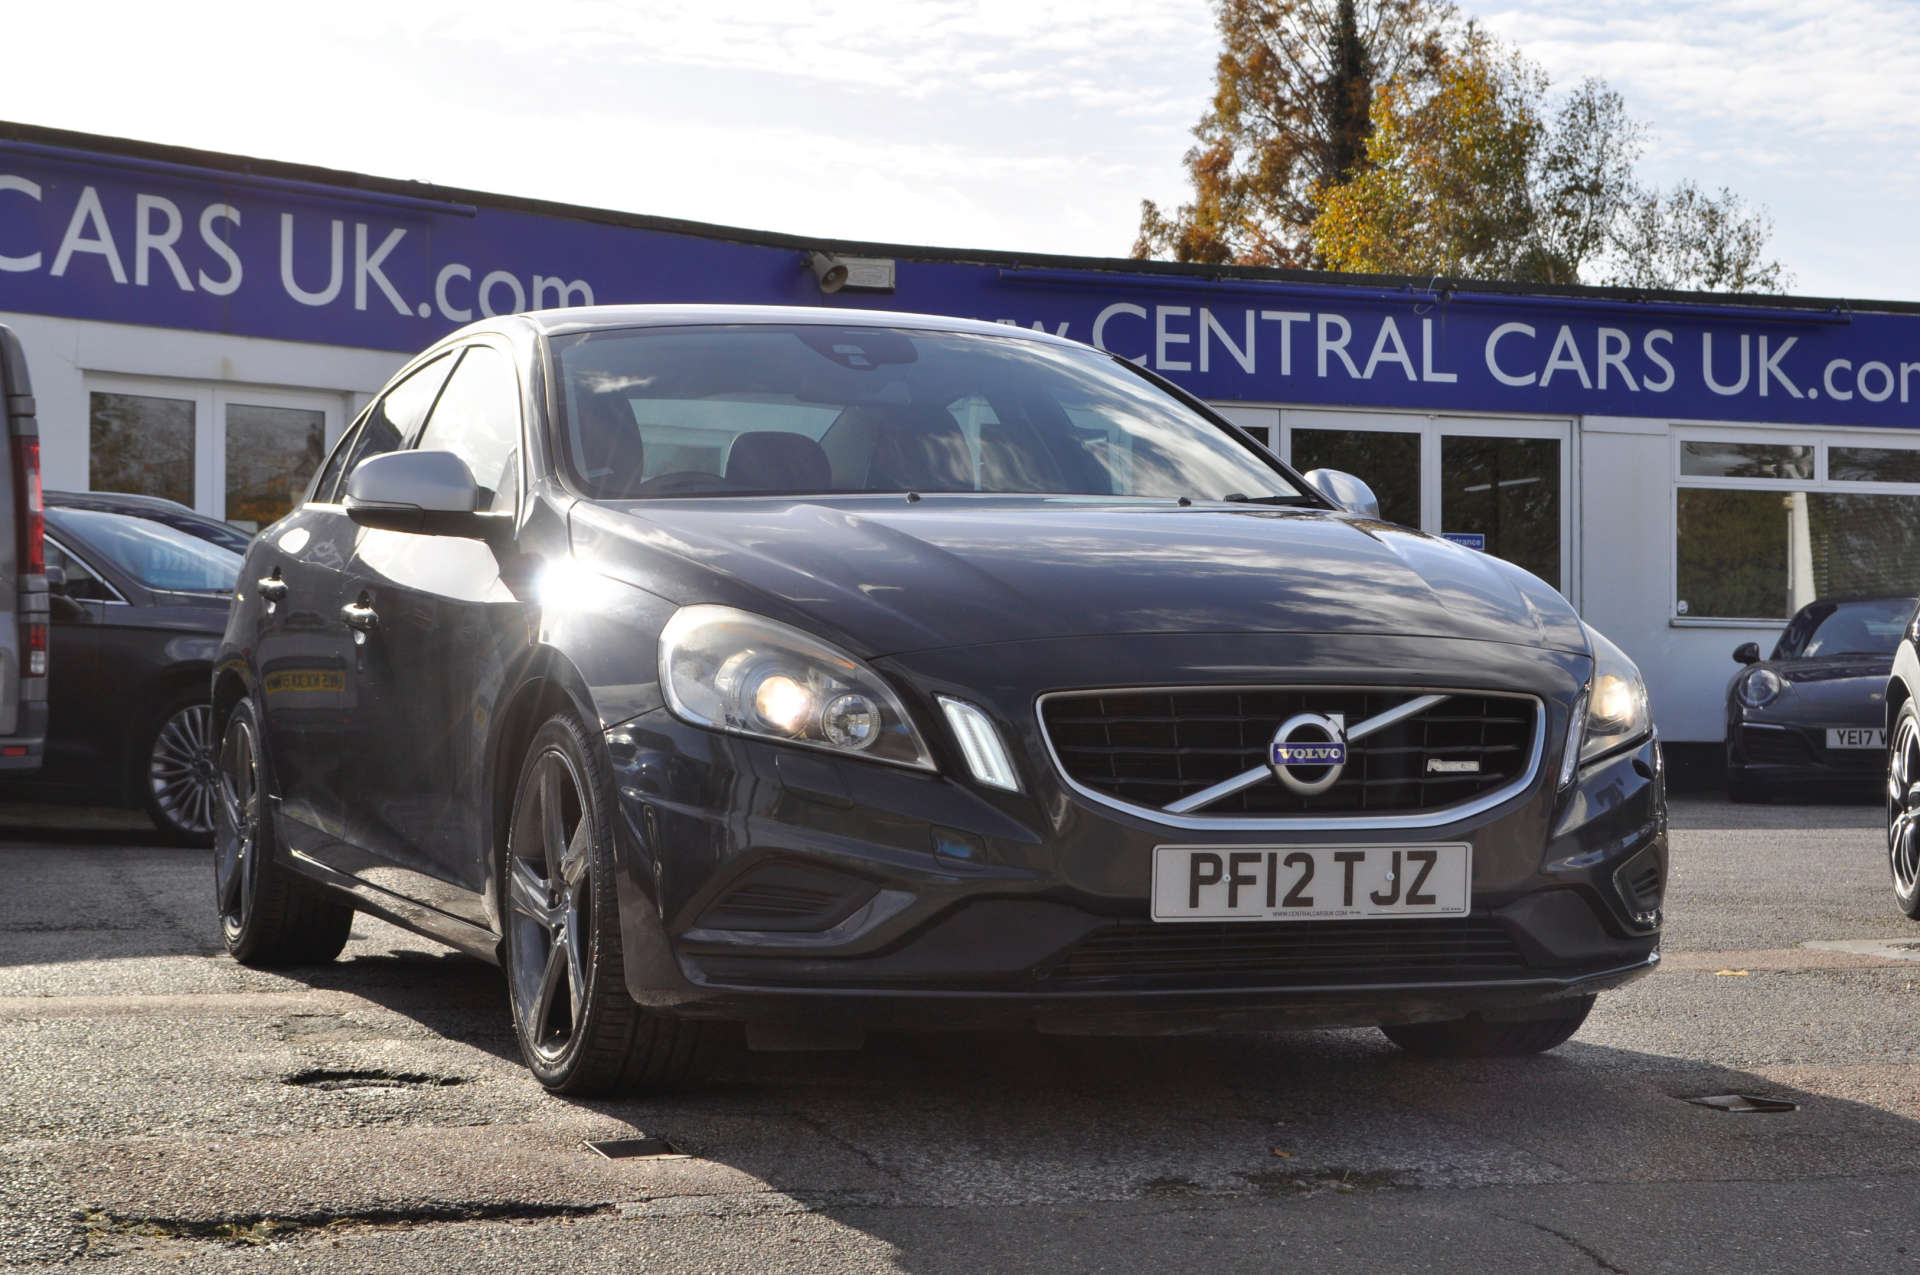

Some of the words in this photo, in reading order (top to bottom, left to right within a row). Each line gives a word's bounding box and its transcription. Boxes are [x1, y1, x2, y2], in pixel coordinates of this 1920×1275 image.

[281, 213, 595, 322] UK.com
[1092, 302, 1458, 383] CENTRAL
[1485, 322, 1675, 392] CARS
[1277, 748, 1341, 760] VOLVO
[1837, 730, 1873, 745] YE17
[1189, 852, 1315, 908] PF12
[1334, 850, 1438, 907] TJZ
